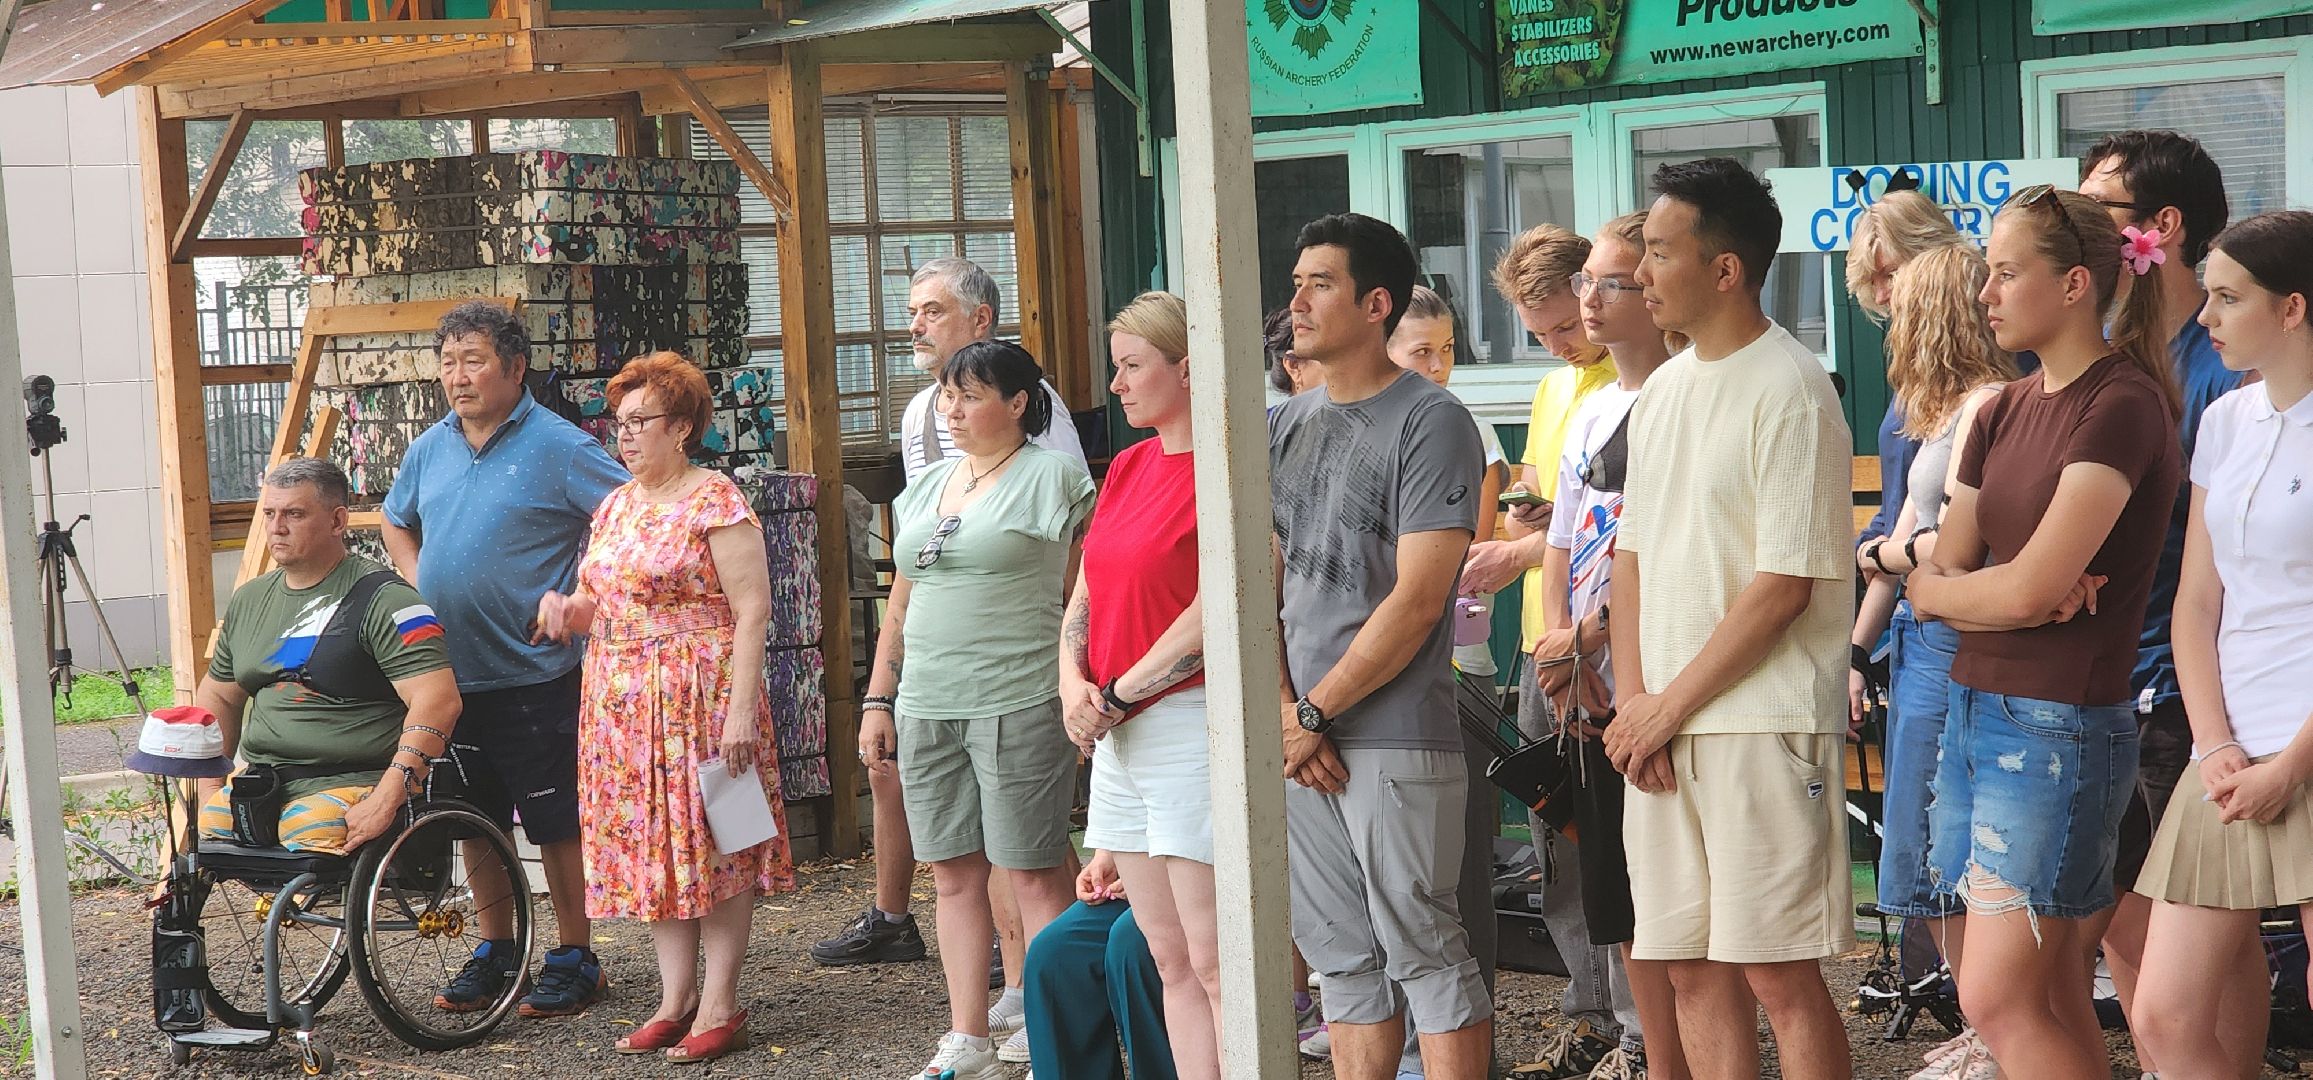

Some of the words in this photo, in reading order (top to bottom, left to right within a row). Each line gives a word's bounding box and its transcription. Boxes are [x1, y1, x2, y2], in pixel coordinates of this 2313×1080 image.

[1511, 16, 1593, 42] STABILIZERS
[1650, 23, 1890, 64] www.newarchery.com
[1251, 36, 1285, 76] RUSSIAN
[1285, 71, 1328, 87] ARCHERY
[1329, 23, 1374, 81] FEDERATION
[1514, 41, 1600, 68] ACCESSORIES
